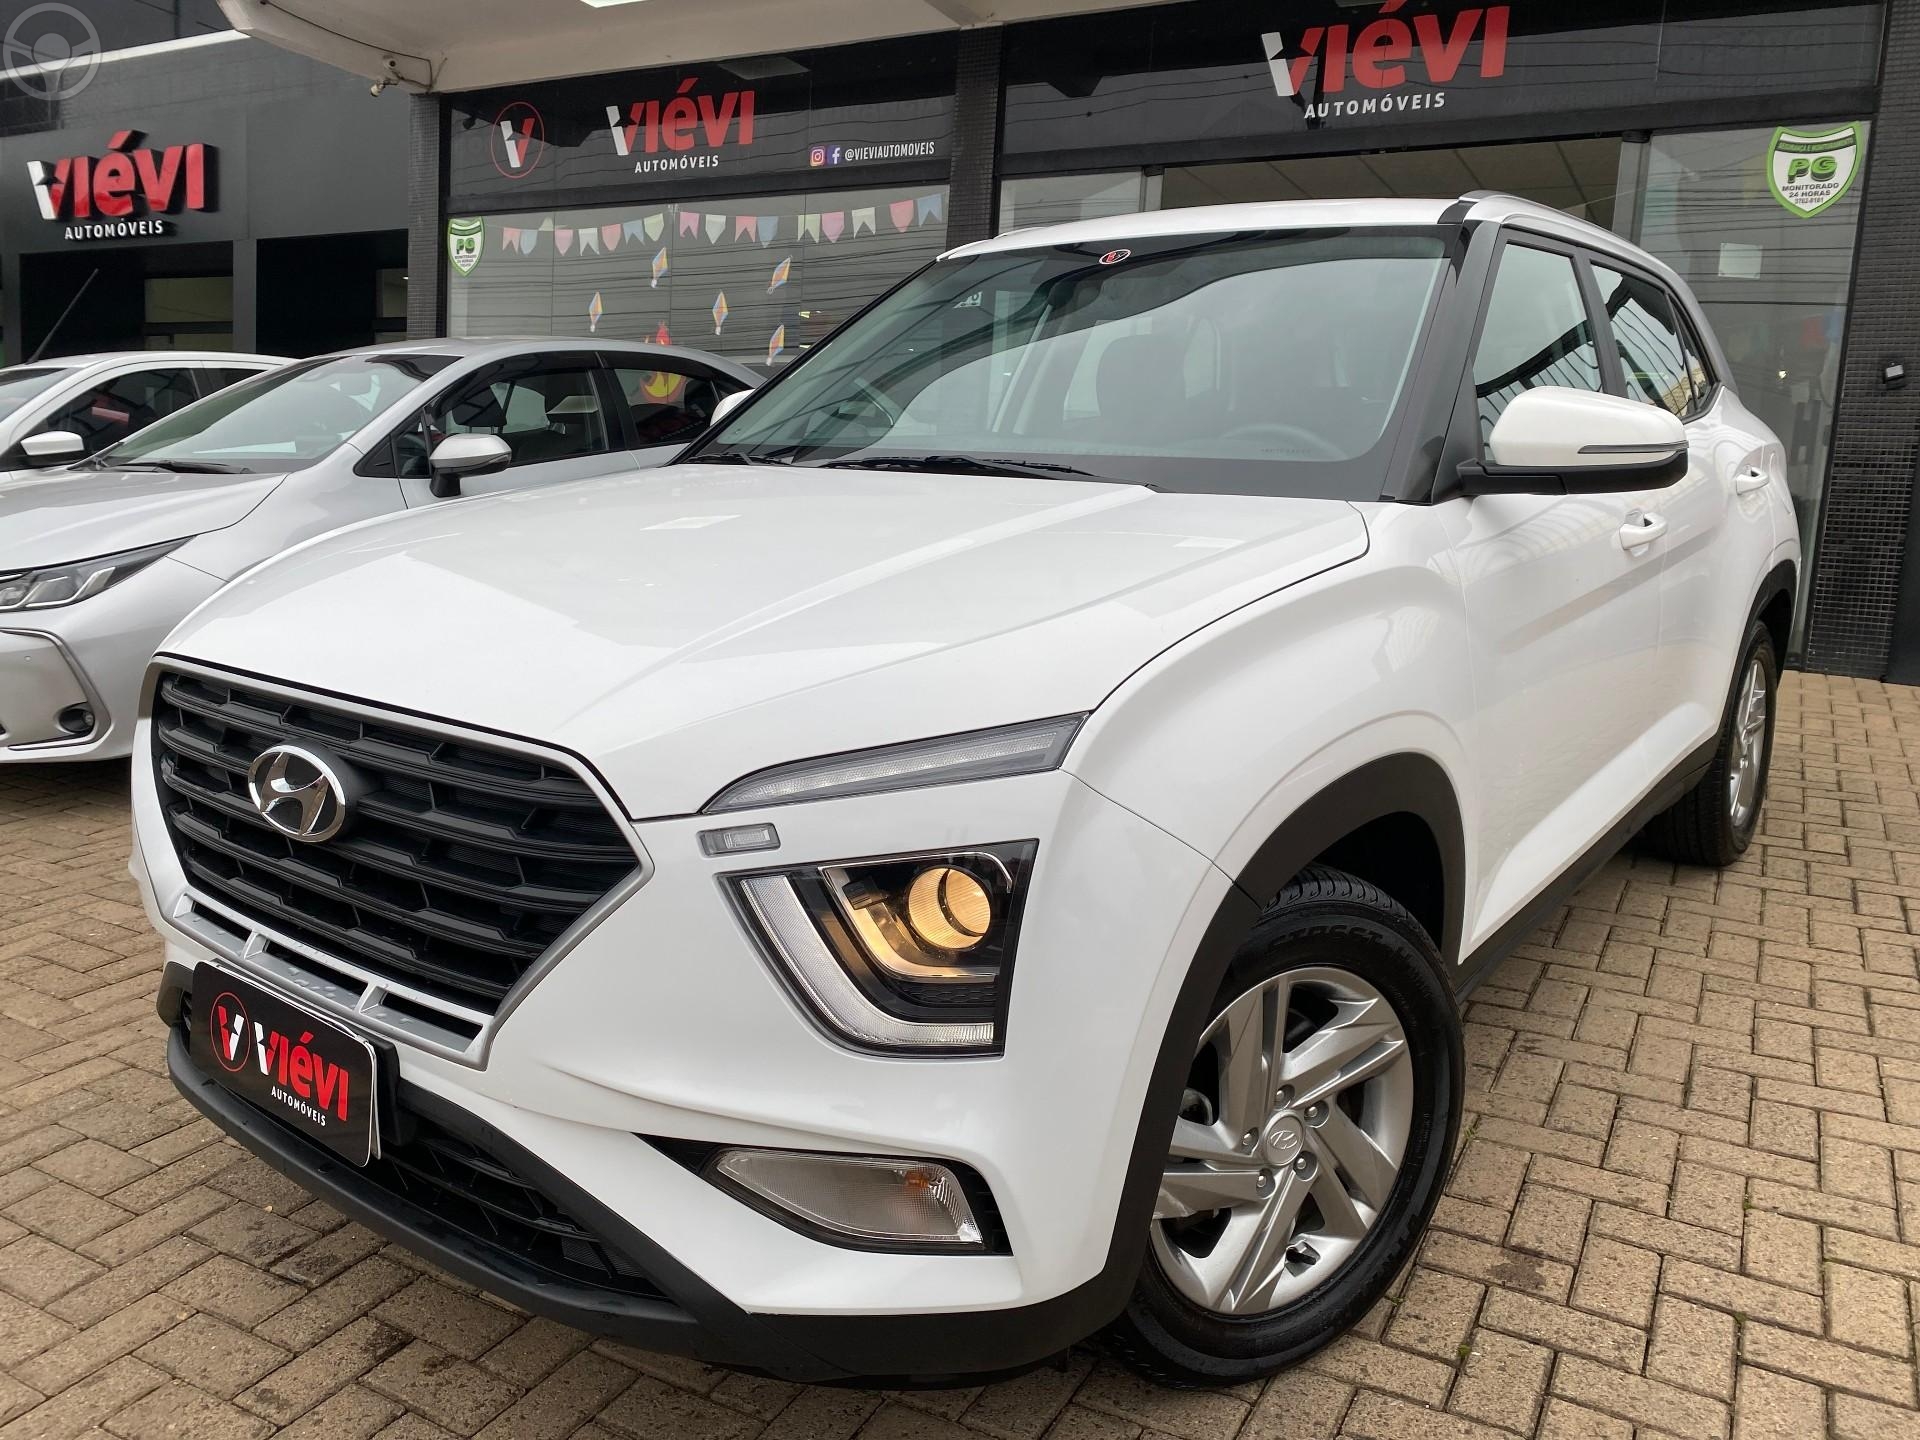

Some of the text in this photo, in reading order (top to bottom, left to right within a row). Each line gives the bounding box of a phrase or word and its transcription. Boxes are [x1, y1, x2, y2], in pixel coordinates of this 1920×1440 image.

[1304, 92, 1446, 119] AUTOMÓVEIS
[844, 141, 935, 162] @VIEVIAUTOMOVEIS
[634, 155, 719, 174] AUTOMÓVEIS
[1787, 155, 1838, 184] PG
[1782, 182, 1839, 192] MONITORADO
[1801, 189, 1831, 197] HORAS
[64, 218, 164, 240] AUTOMÓVEIS
[271, 1085, 326, 1126] AUTOMÓVEIS
